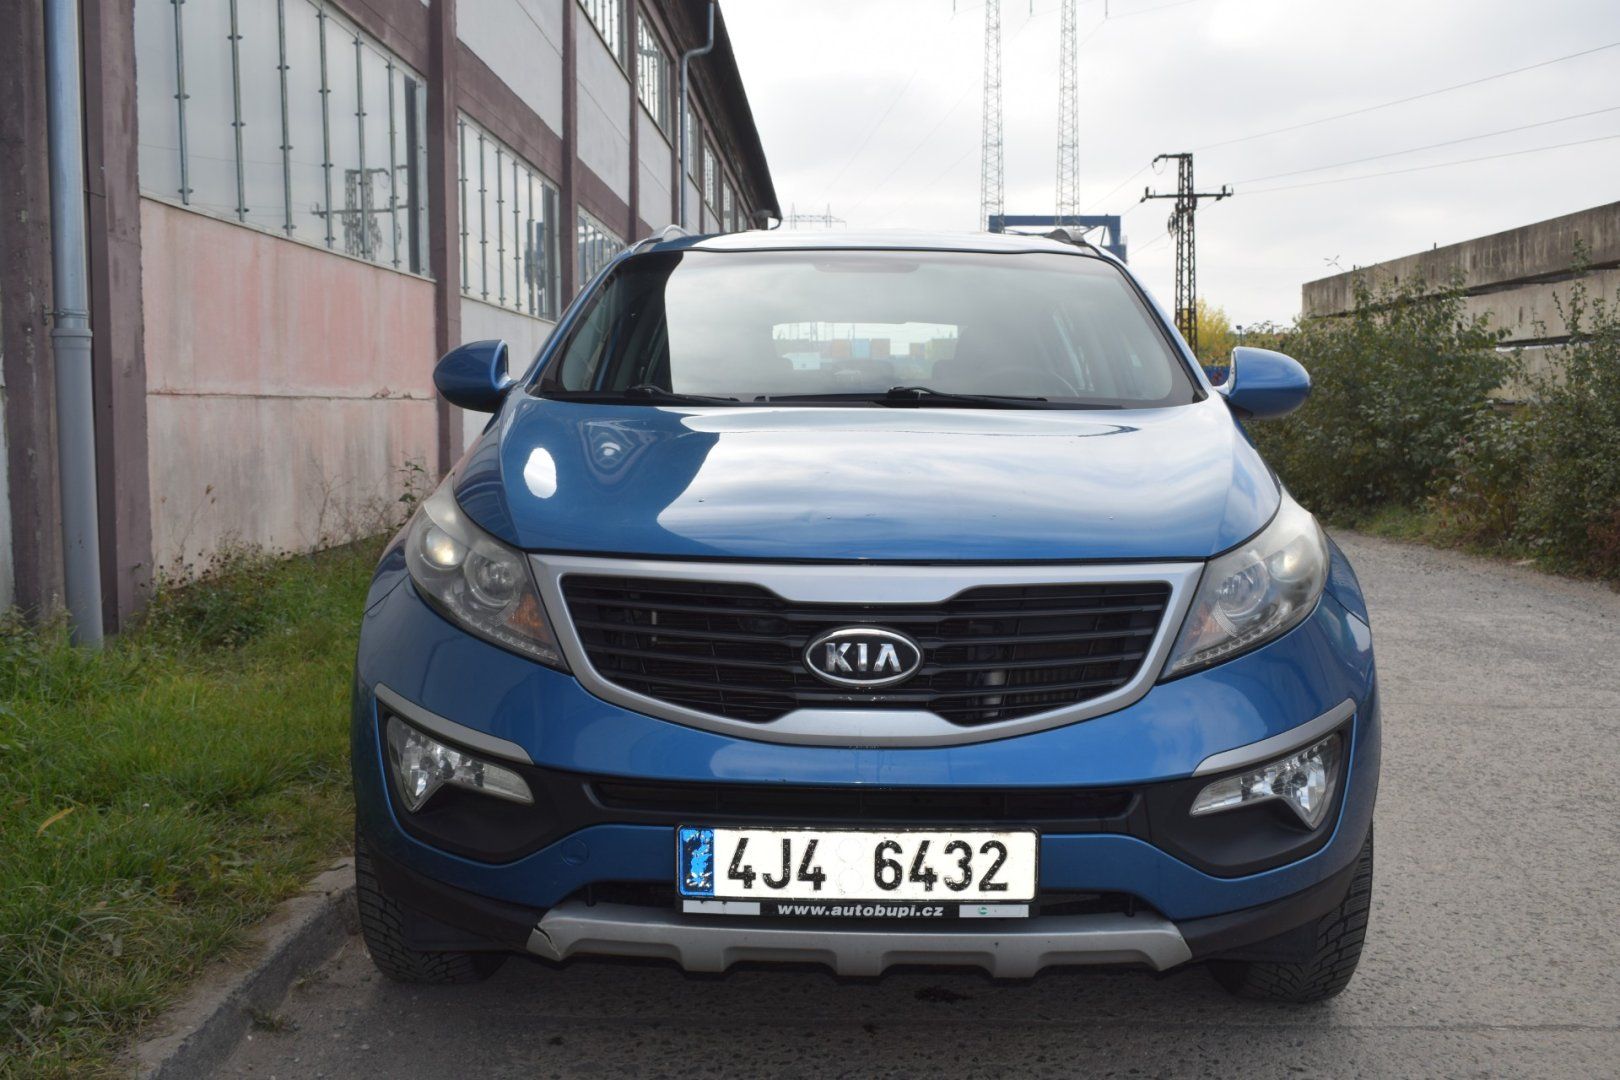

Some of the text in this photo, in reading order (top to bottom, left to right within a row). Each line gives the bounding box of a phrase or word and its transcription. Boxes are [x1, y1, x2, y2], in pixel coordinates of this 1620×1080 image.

[825, 642, 902, 672] KIA
[727, 837, 1009, 892] 4J4 6432
[777, 904, 943, 918] www.autobupi.cz
